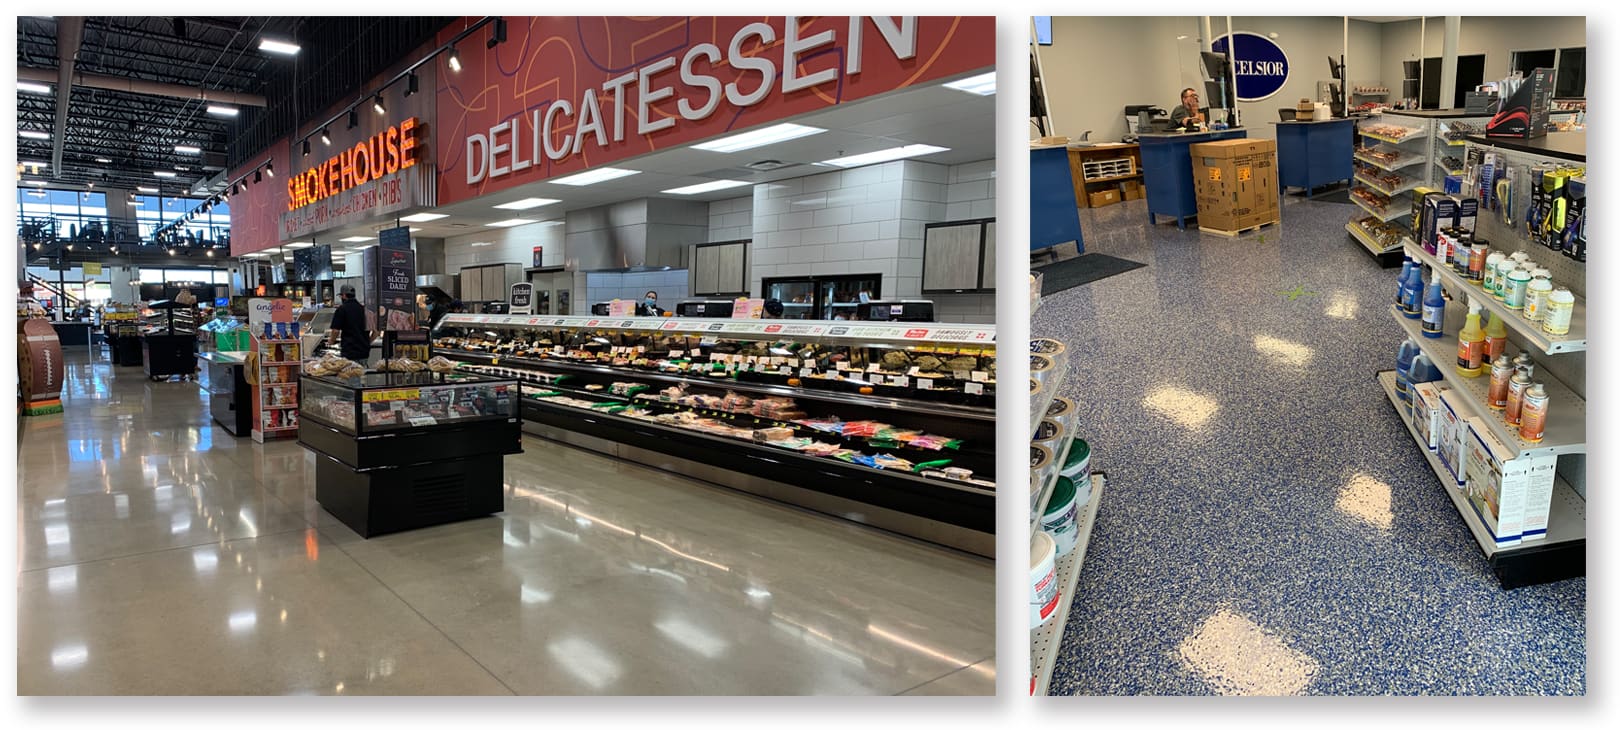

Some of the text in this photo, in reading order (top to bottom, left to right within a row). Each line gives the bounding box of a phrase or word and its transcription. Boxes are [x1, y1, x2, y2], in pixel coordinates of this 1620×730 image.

[466, 16, 918, 184] DELICATESSEN
[287, 117, 417, 211] SMOKEHOUSE
[383, 179, 401, 206] RIBS
[387, 276, 409, 284] SLICED
[389, 283, 407, 291] DAILY
